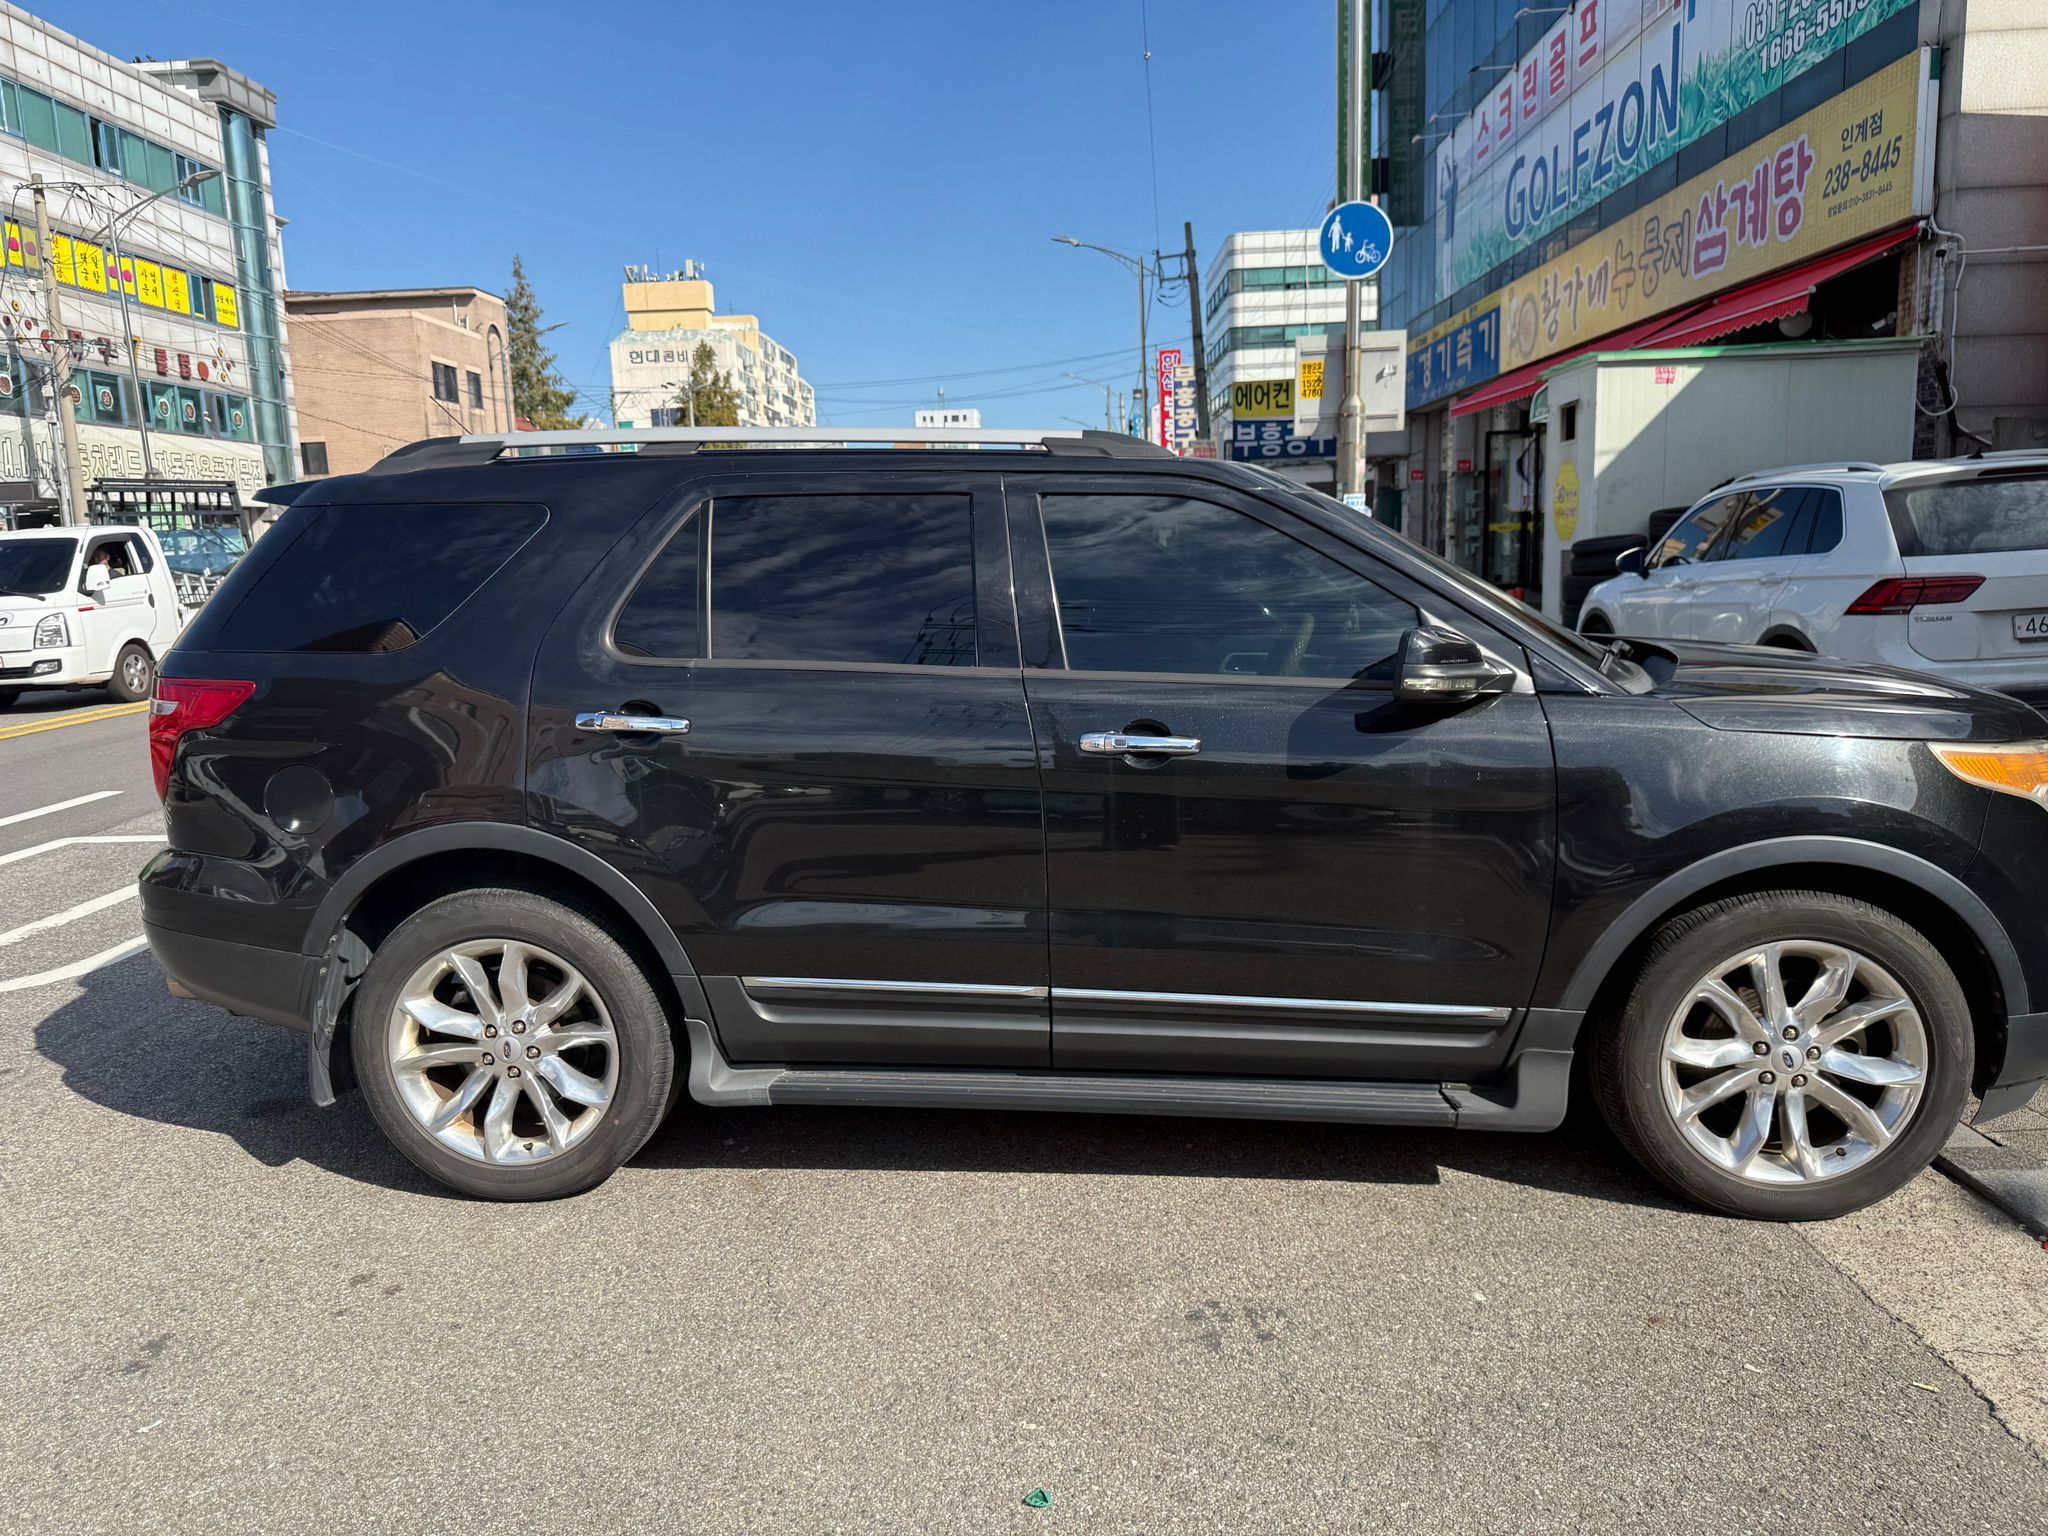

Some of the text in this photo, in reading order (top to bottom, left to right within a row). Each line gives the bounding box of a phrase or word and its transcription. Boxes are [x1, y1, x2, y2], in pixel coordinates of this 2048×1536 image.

[1760, 0, 1868, 75] 1666-550
[1476, 0, 1598, 160] 스크린골프
[1504, 21, 1681, 240] GOLFZON
[1822, 134, 1903, 200] 238-8445
[1841, 108, 1883, 152] 인계점
[1611, 209, 1691, 311] 누룽지
[1692, 135, 1815, 280] 삼계탕
[1235, 381, 1290, 411] 에어컨
